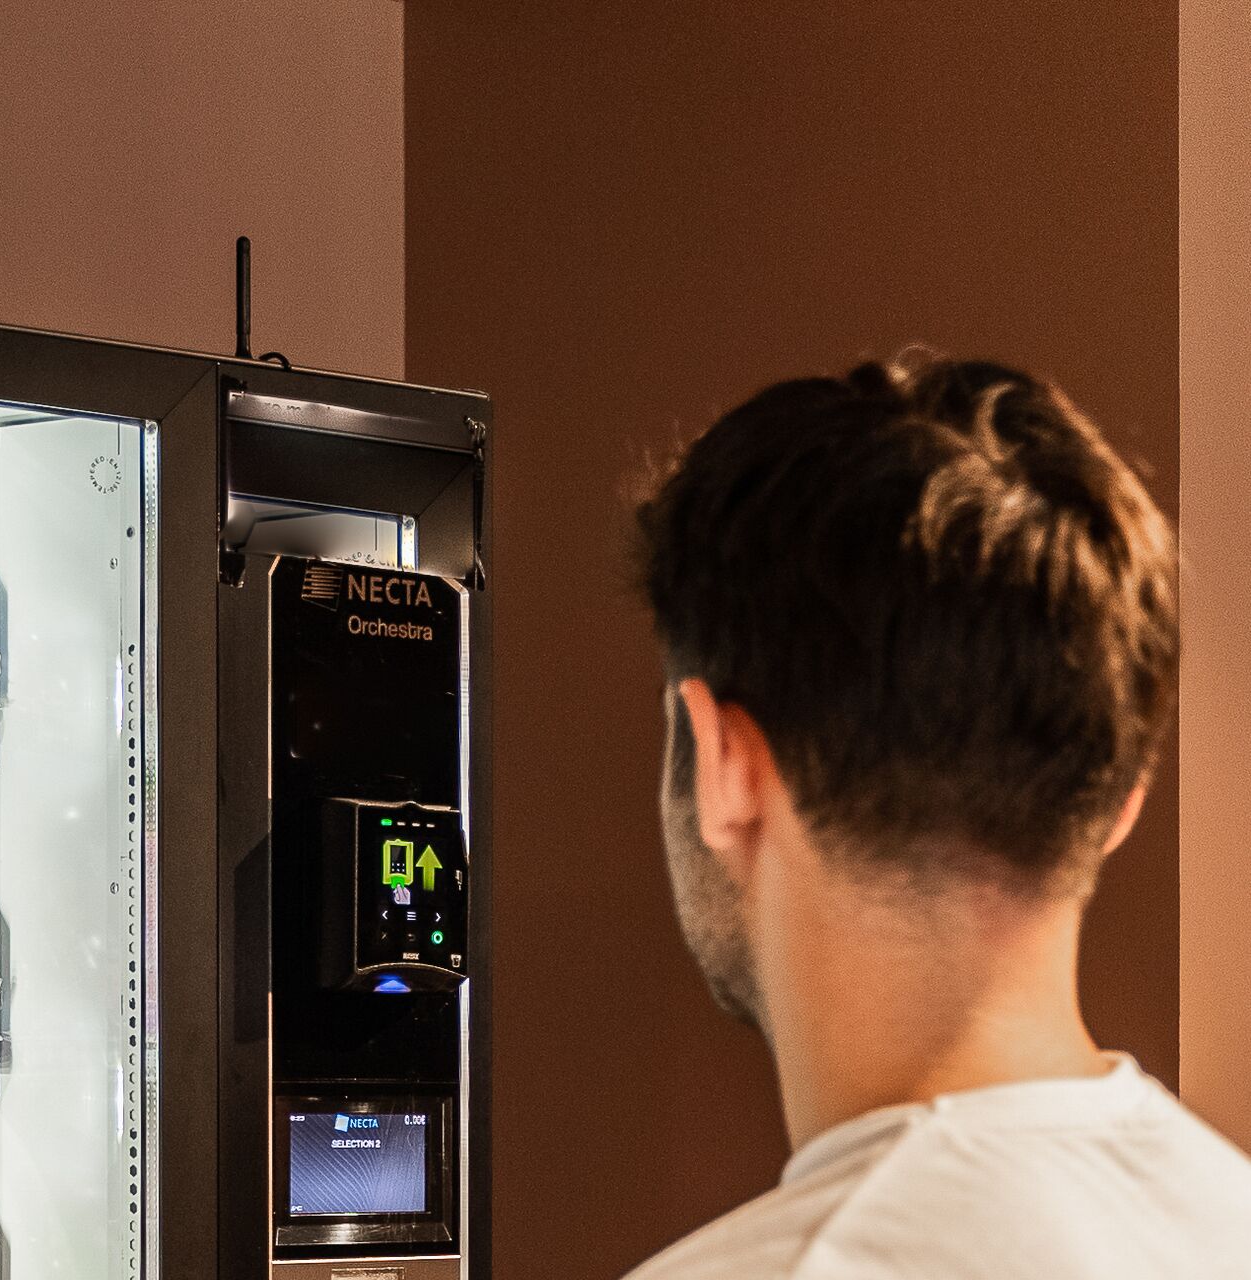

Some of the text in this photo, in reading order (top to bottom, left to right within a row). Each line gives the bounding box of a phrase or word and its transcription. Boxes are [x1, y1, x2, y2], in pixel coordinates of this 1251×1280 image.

[348, 573, 433, 608] NECTA
[348, 614, 434, 641] Orchestra
[349, 1117, 380, 1129] NECTA
[331, 1139, 382, 1149] SELECTION 2
